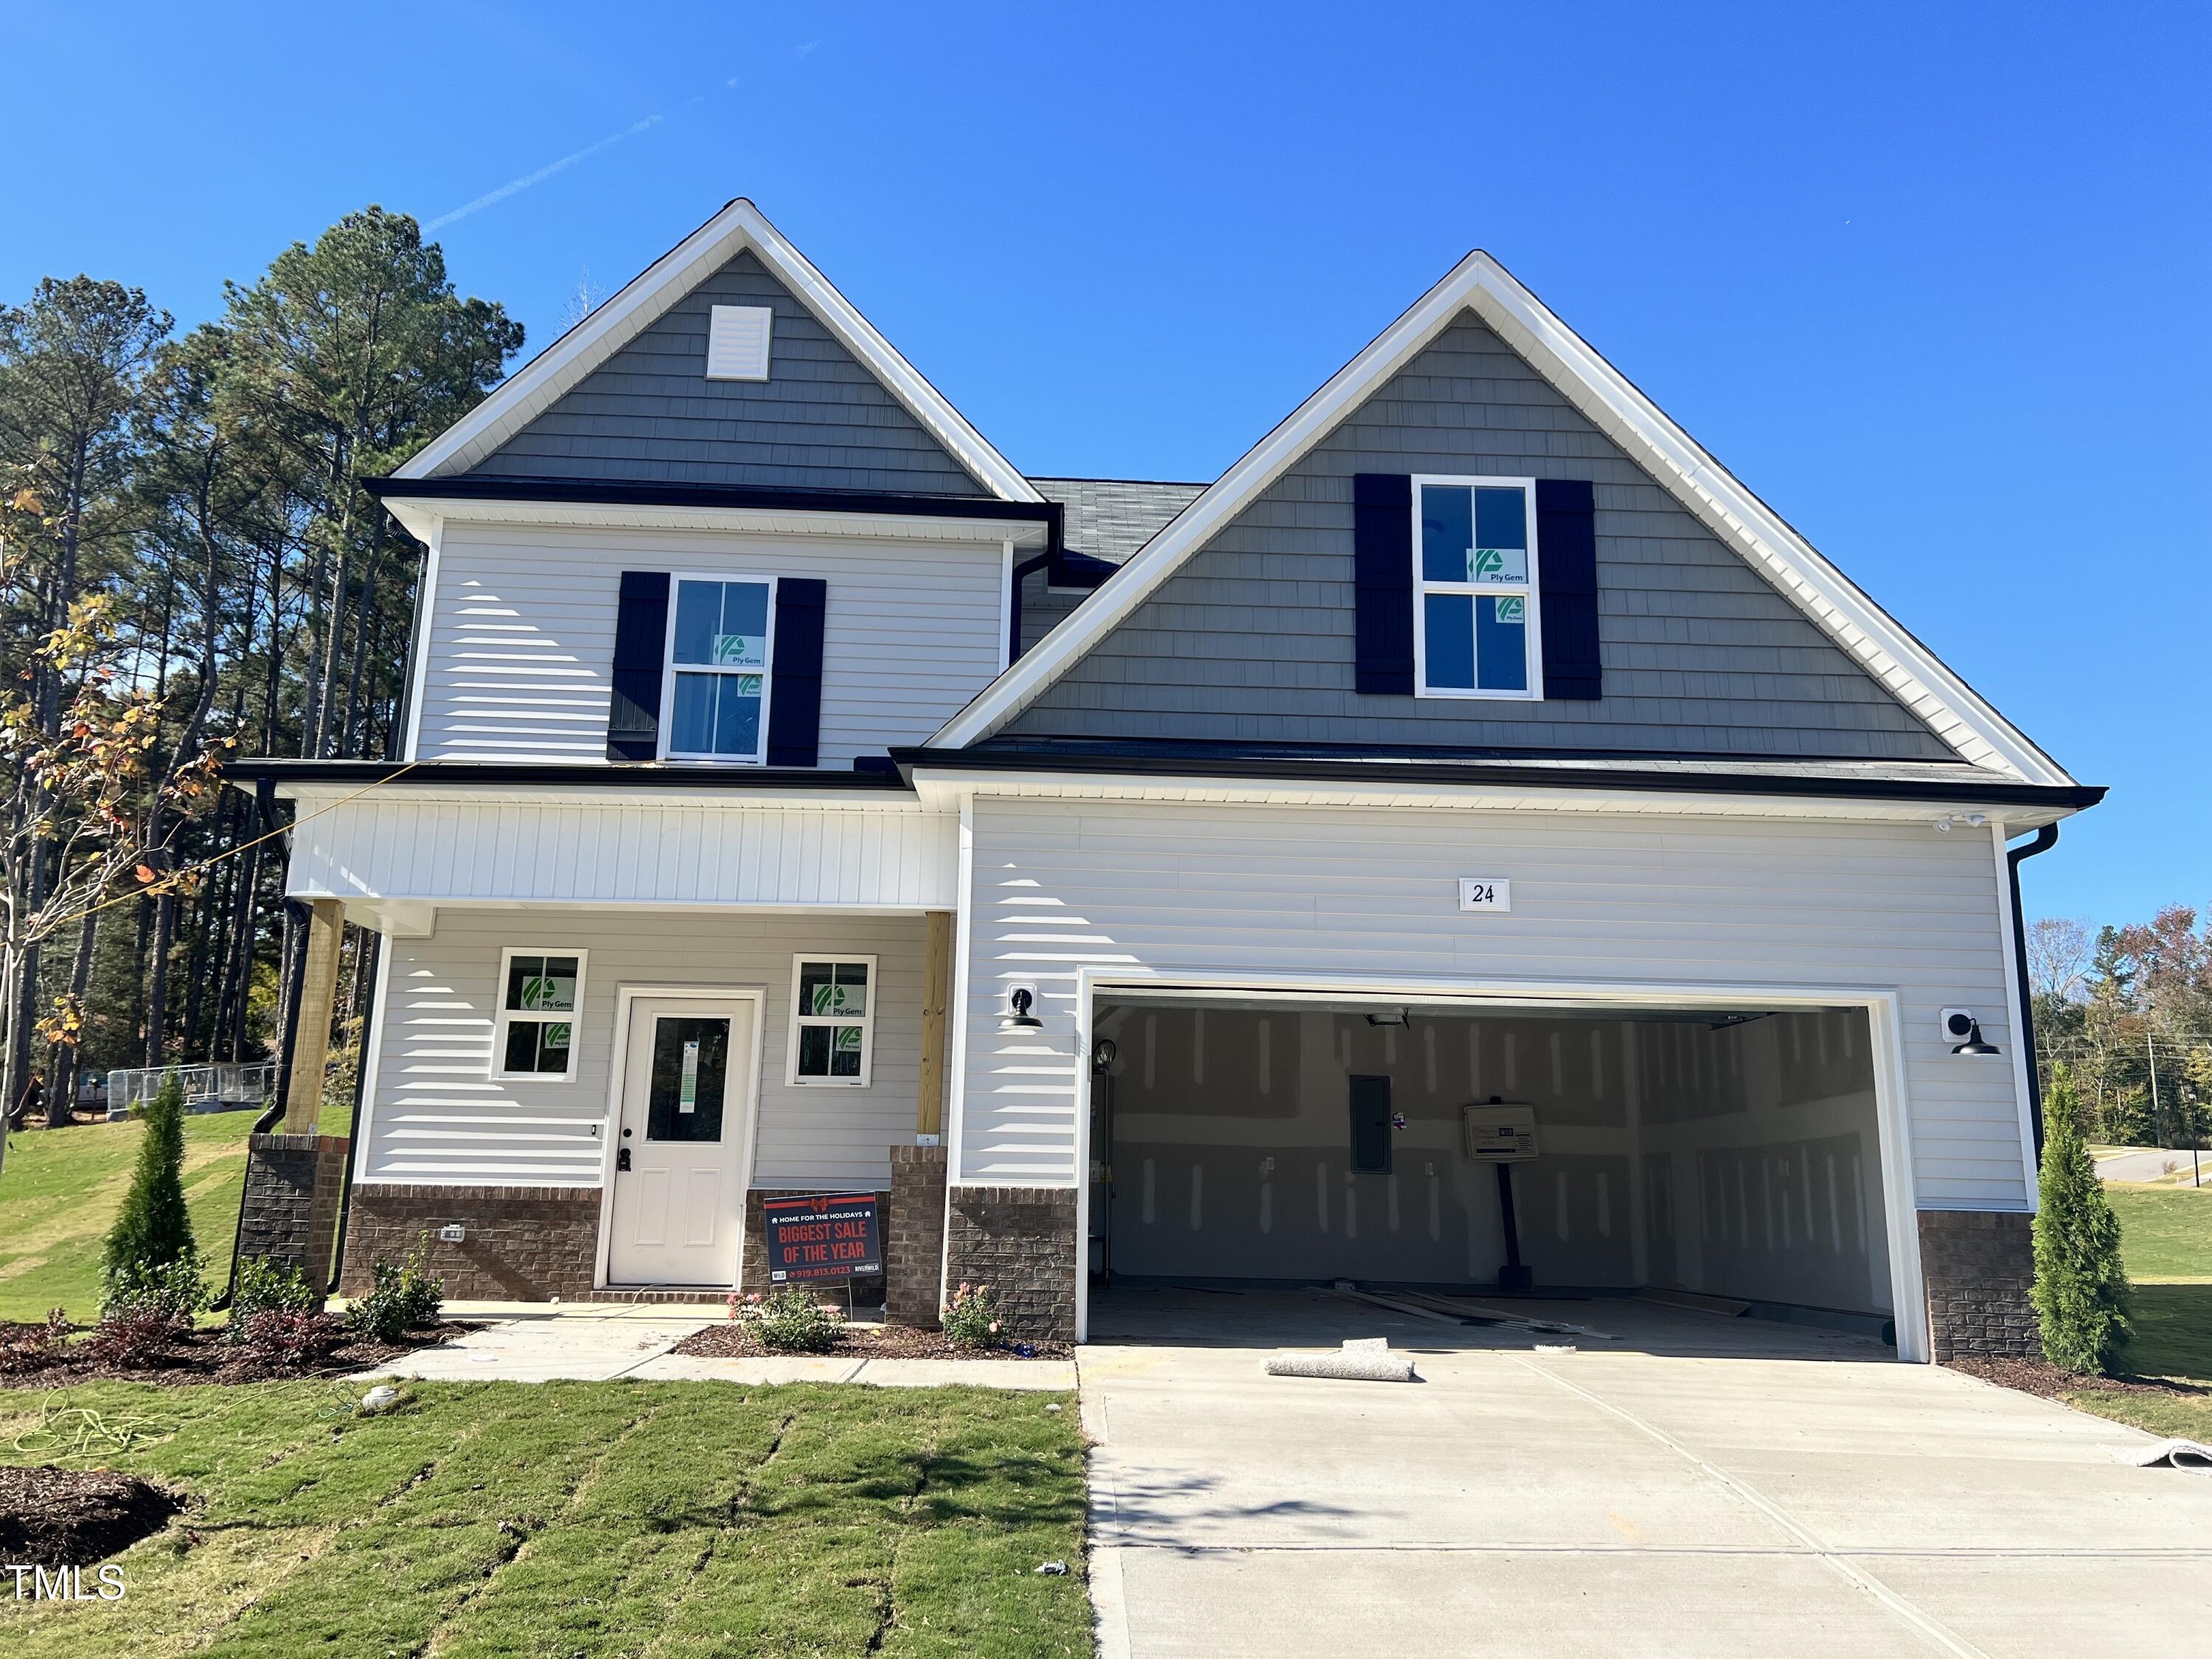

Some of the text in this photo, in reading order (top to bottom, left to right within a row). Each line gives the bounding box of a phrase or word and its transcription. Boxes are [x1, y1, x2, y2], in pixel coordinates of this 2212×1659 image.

[1491, 574, 1504, 582] Ply
[1472, 885, 1494, 902] 24
[542, 1001, 554, 1009] Ply
[833, 1008, 845, 1016] Ply
[779, 1221, 866, 1243] BIGGEST SALE
[783, 1242, 866, 1263] OF THE YEAR
[796, 1266, 851, 1277] 919.813.0123
[855, 1264, 879, 1272] RIVERWILD
